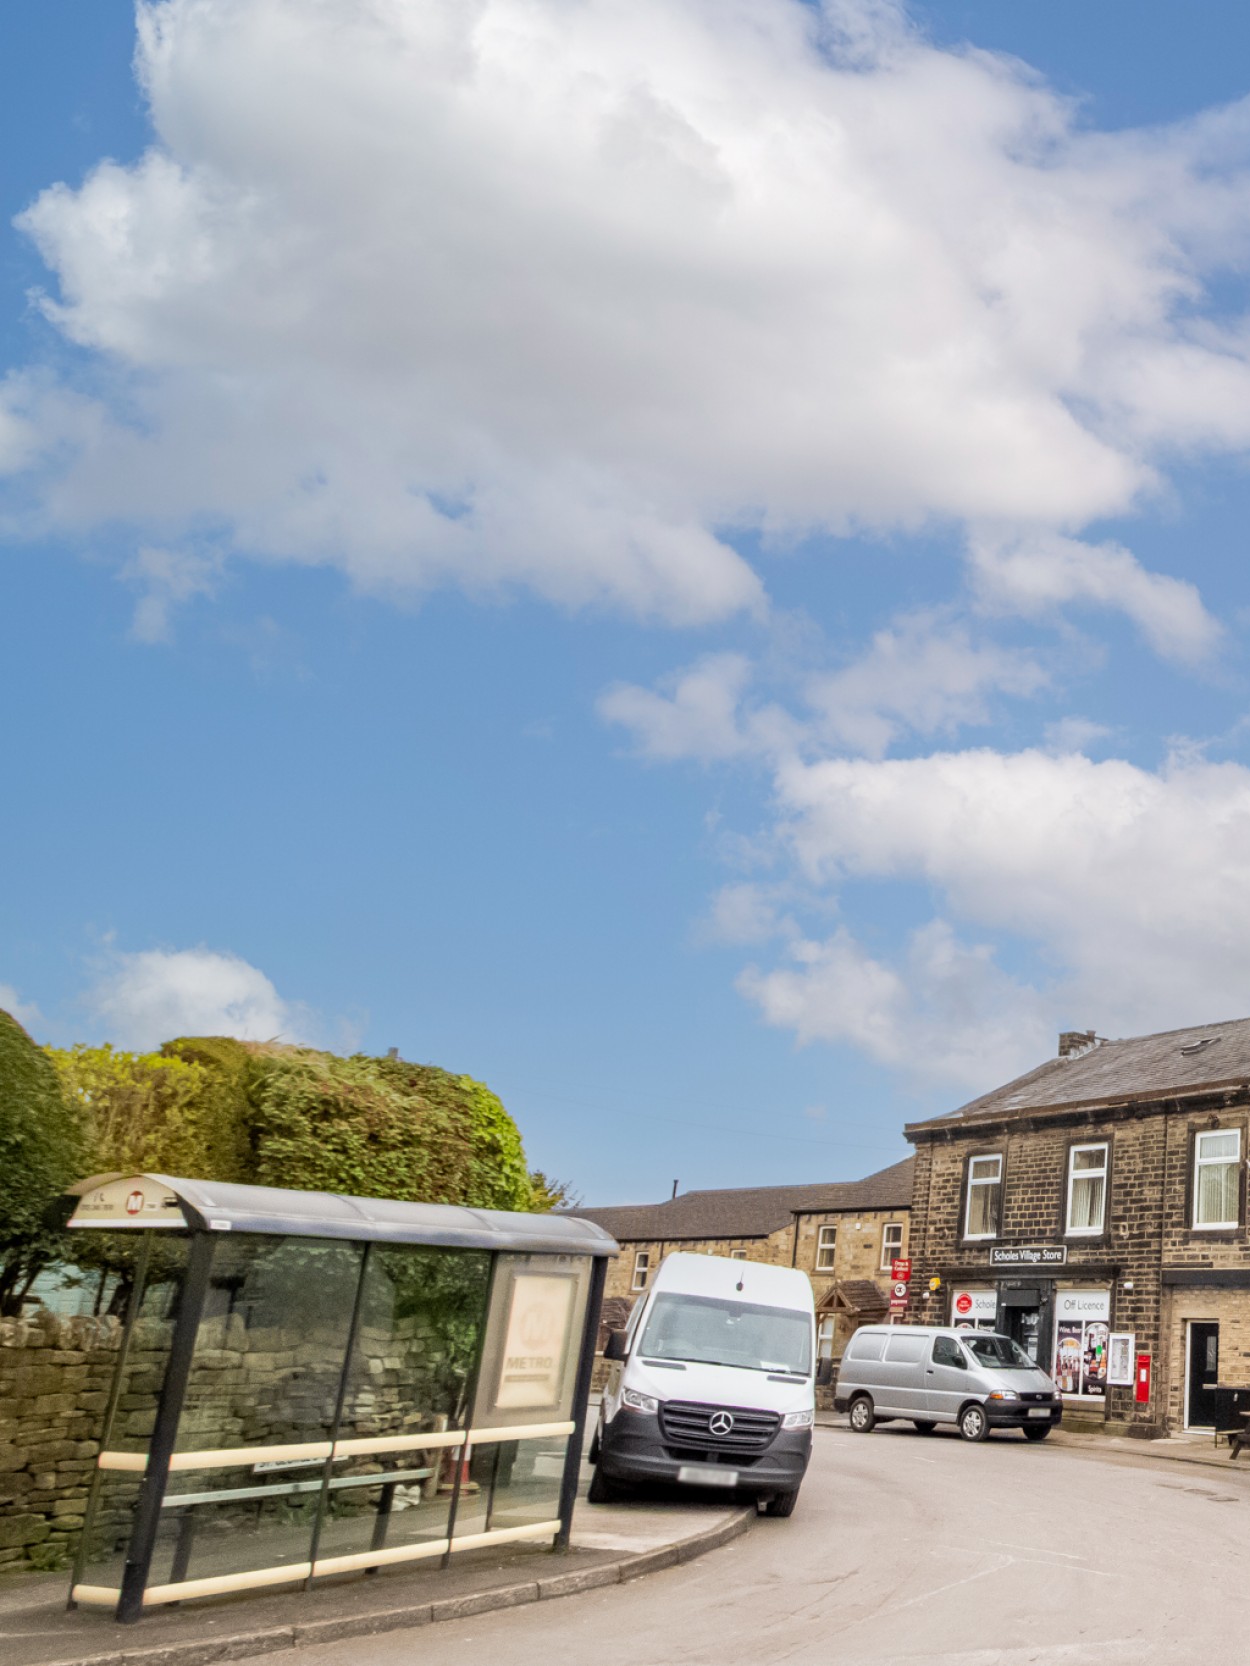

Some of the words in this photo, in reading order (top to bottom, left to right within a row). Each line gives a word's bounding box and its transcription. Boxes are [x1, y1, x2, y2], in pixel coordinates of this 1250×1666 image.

[994, 1250, 1018, 1261] Scholes
[1019, 1249, 1041, 1263] Village
[1042, 1249, 1062, 1260] Store
[975, 1299, 996, 1309] Schole
[1064, 1299, 1077, 1310] Off
[1077, 1299, 1105, 1311] Licence
[505, 1356, 553, 1369] METRO
[1087, 1384, 1102, 1393] Spirits
